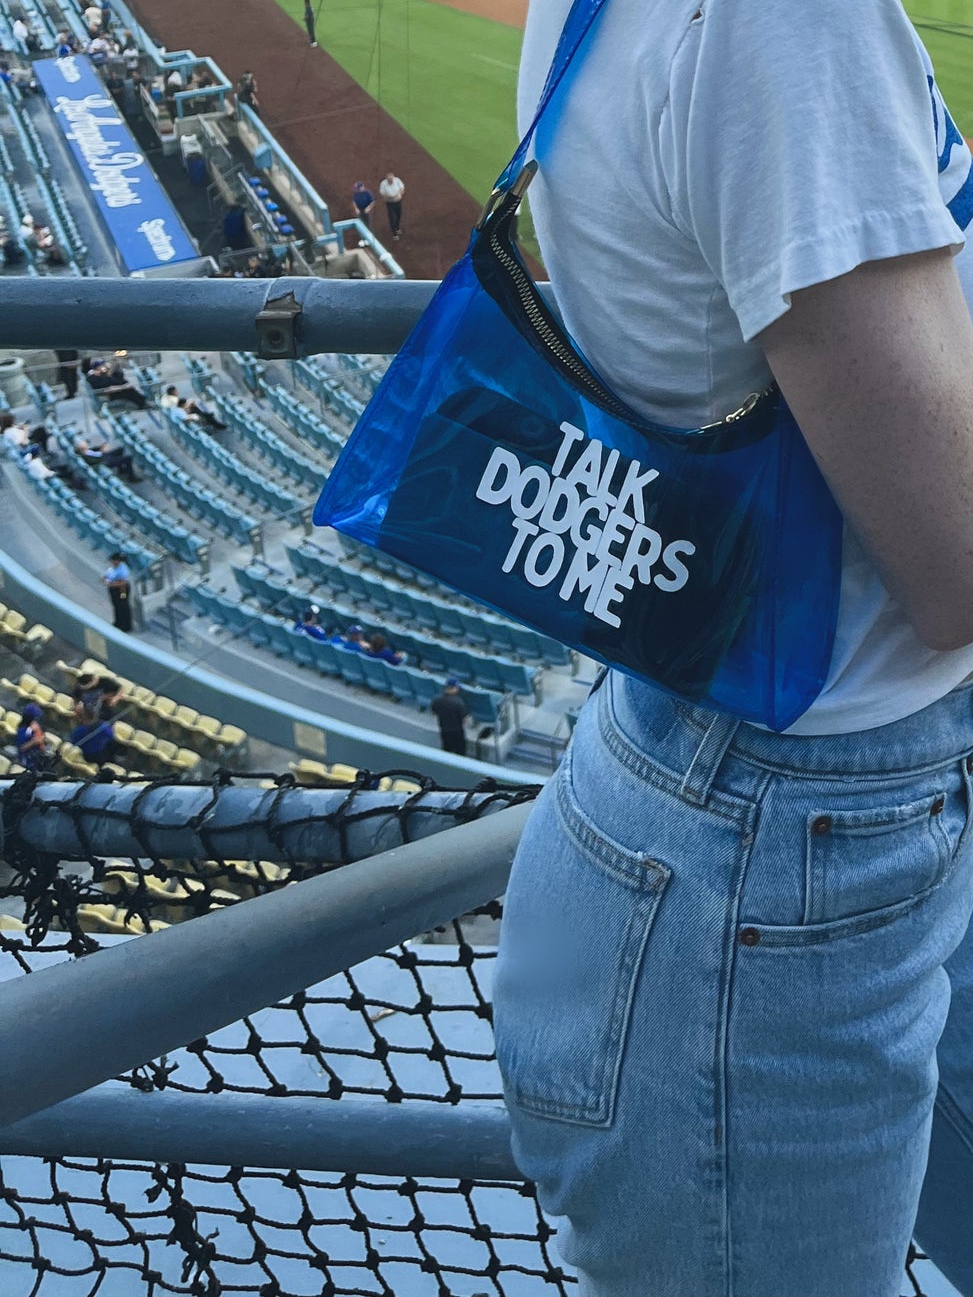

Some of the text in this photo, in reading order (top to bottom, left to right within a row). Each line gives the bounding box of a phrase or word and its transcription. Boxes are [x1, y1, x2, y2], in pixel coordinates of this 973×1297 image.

[475, 446, 696, 593] DODGERS
[551, 421, 660, 524] TALK
[501, 517, 635, 630] TO ME
